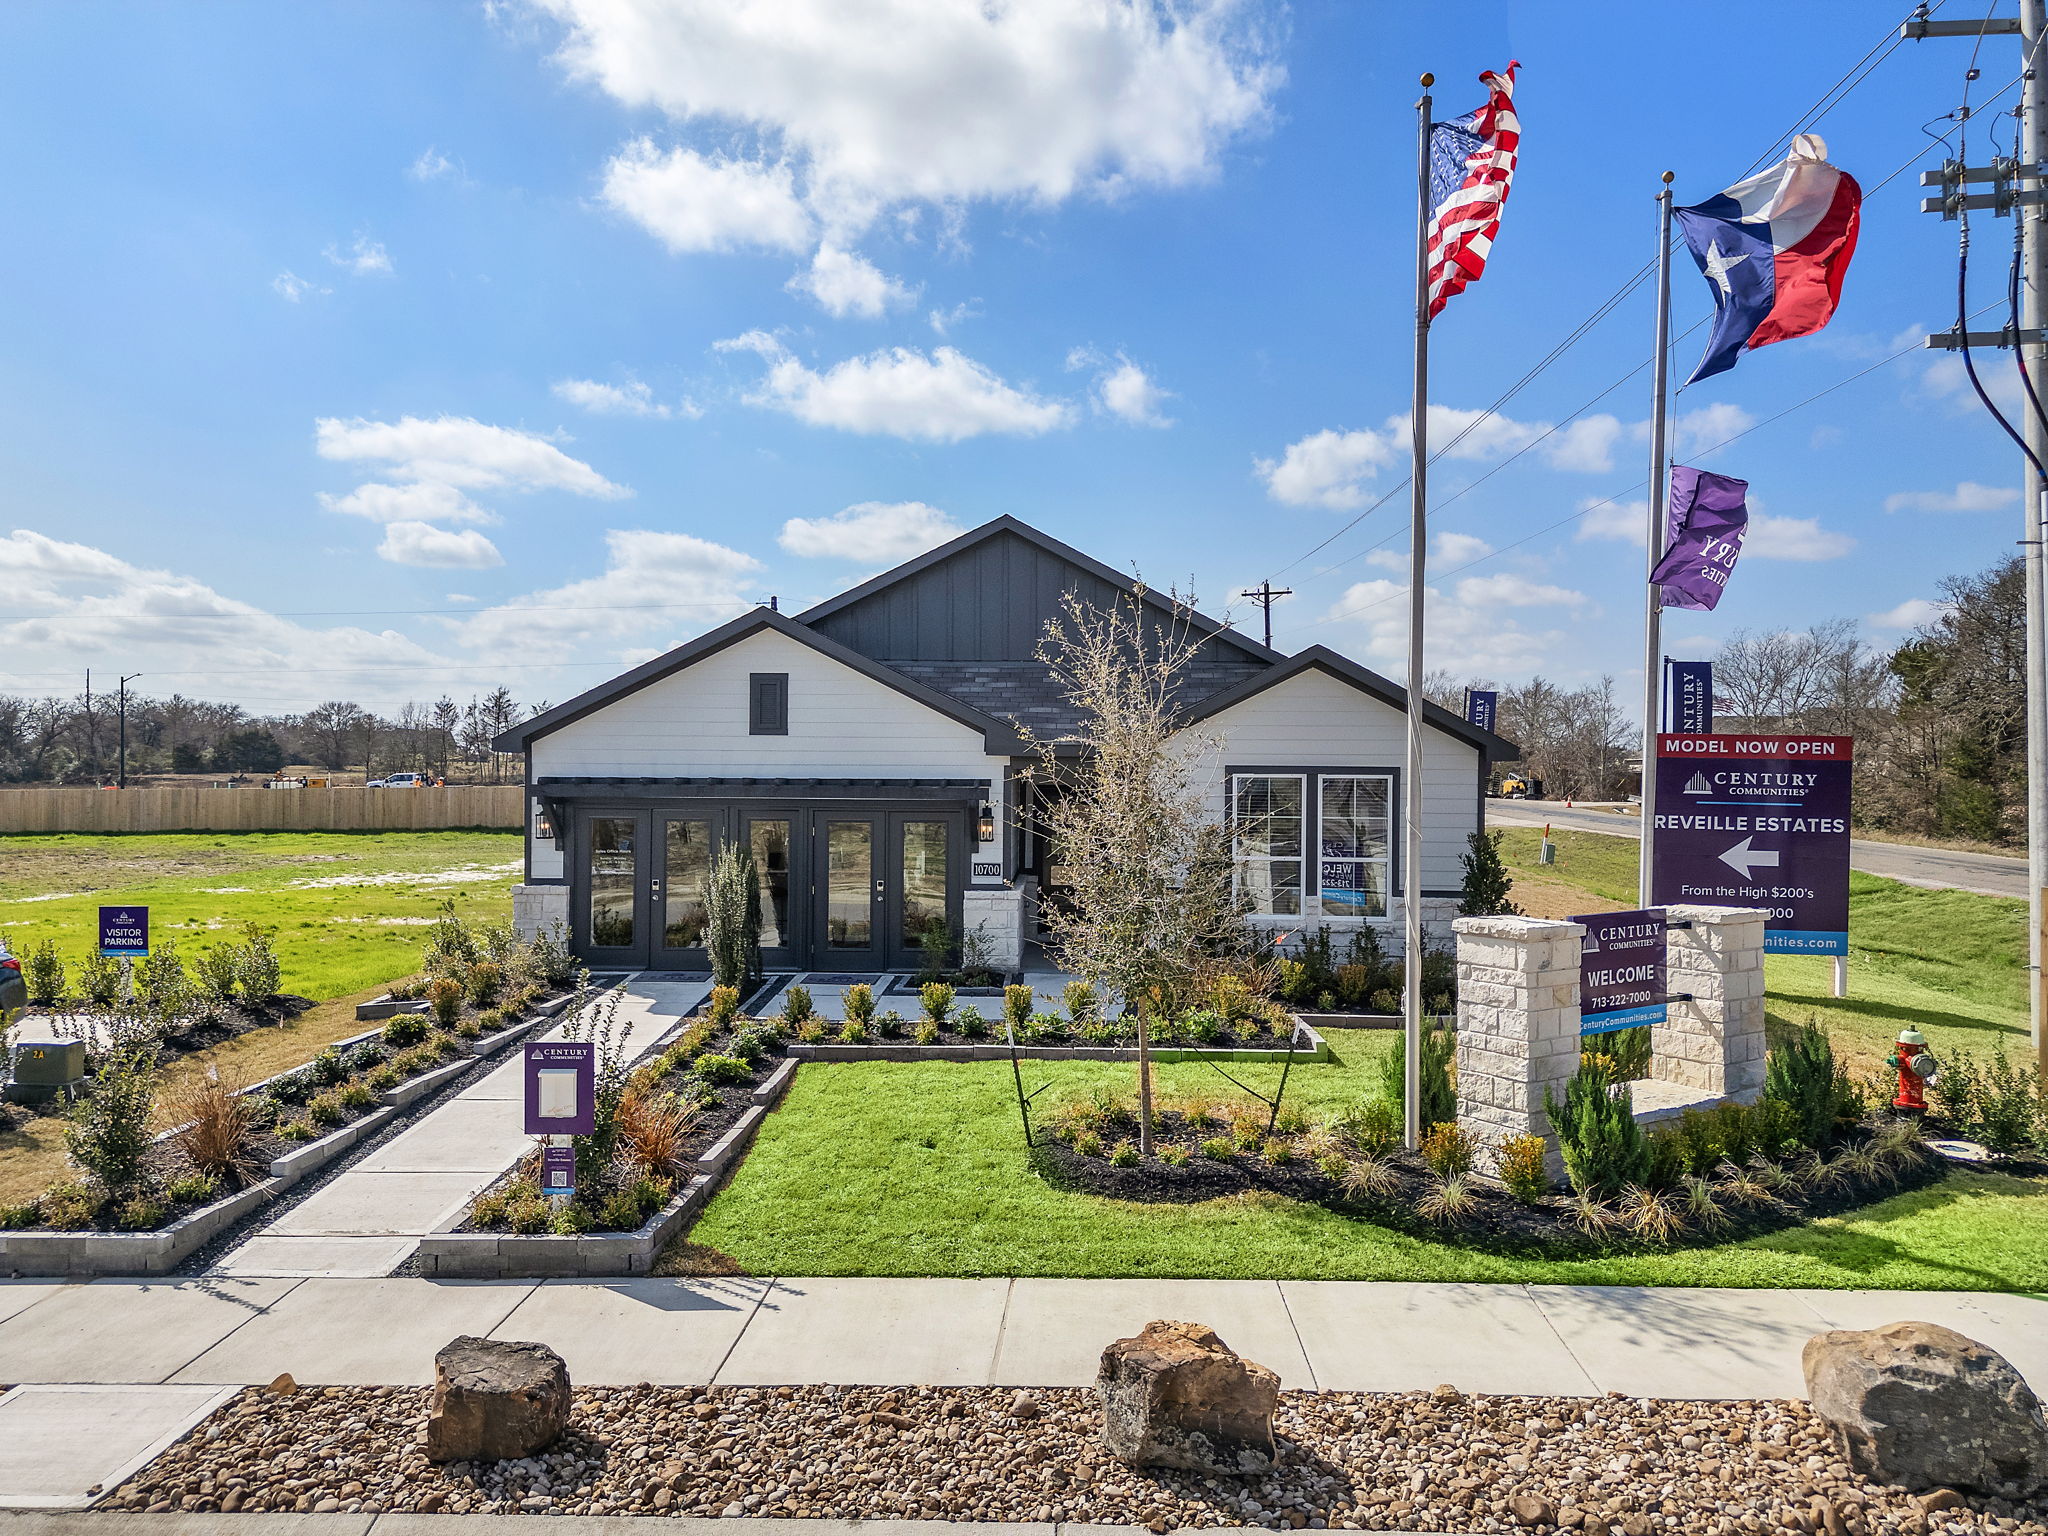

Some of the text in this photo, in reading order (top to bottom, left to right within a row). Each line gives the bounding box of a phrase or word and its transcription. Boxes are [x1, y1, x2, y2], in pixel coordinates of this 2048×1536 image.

[1684, 672, 1694, 734] NTURY
[1476, 698, 1484, 727] TURY
[1666, 740, 1835, 754] MODEL NOW OPEN
[1714, 772, 1818, 786] CENTURY
[1730, 787, 1806, 796] COMMUNITIES
[1654, 814, 1845, 833] REVEILLE ESTATES
[974, 864, 1000, 875] 10700
[1681, 885, 1814, 900] From the High $200's
[1762, 907, 1794, 919] 000
[1600, 923, 1660, 940] CENTURY
[1609, 939, 1654, 951] COMMUNITIES
[1765, 936, 1837, 948] nities.com
[1588, 964, 1654, 987] WELCOME
[1592, 990, 1651, 1008] 713-222-7000
